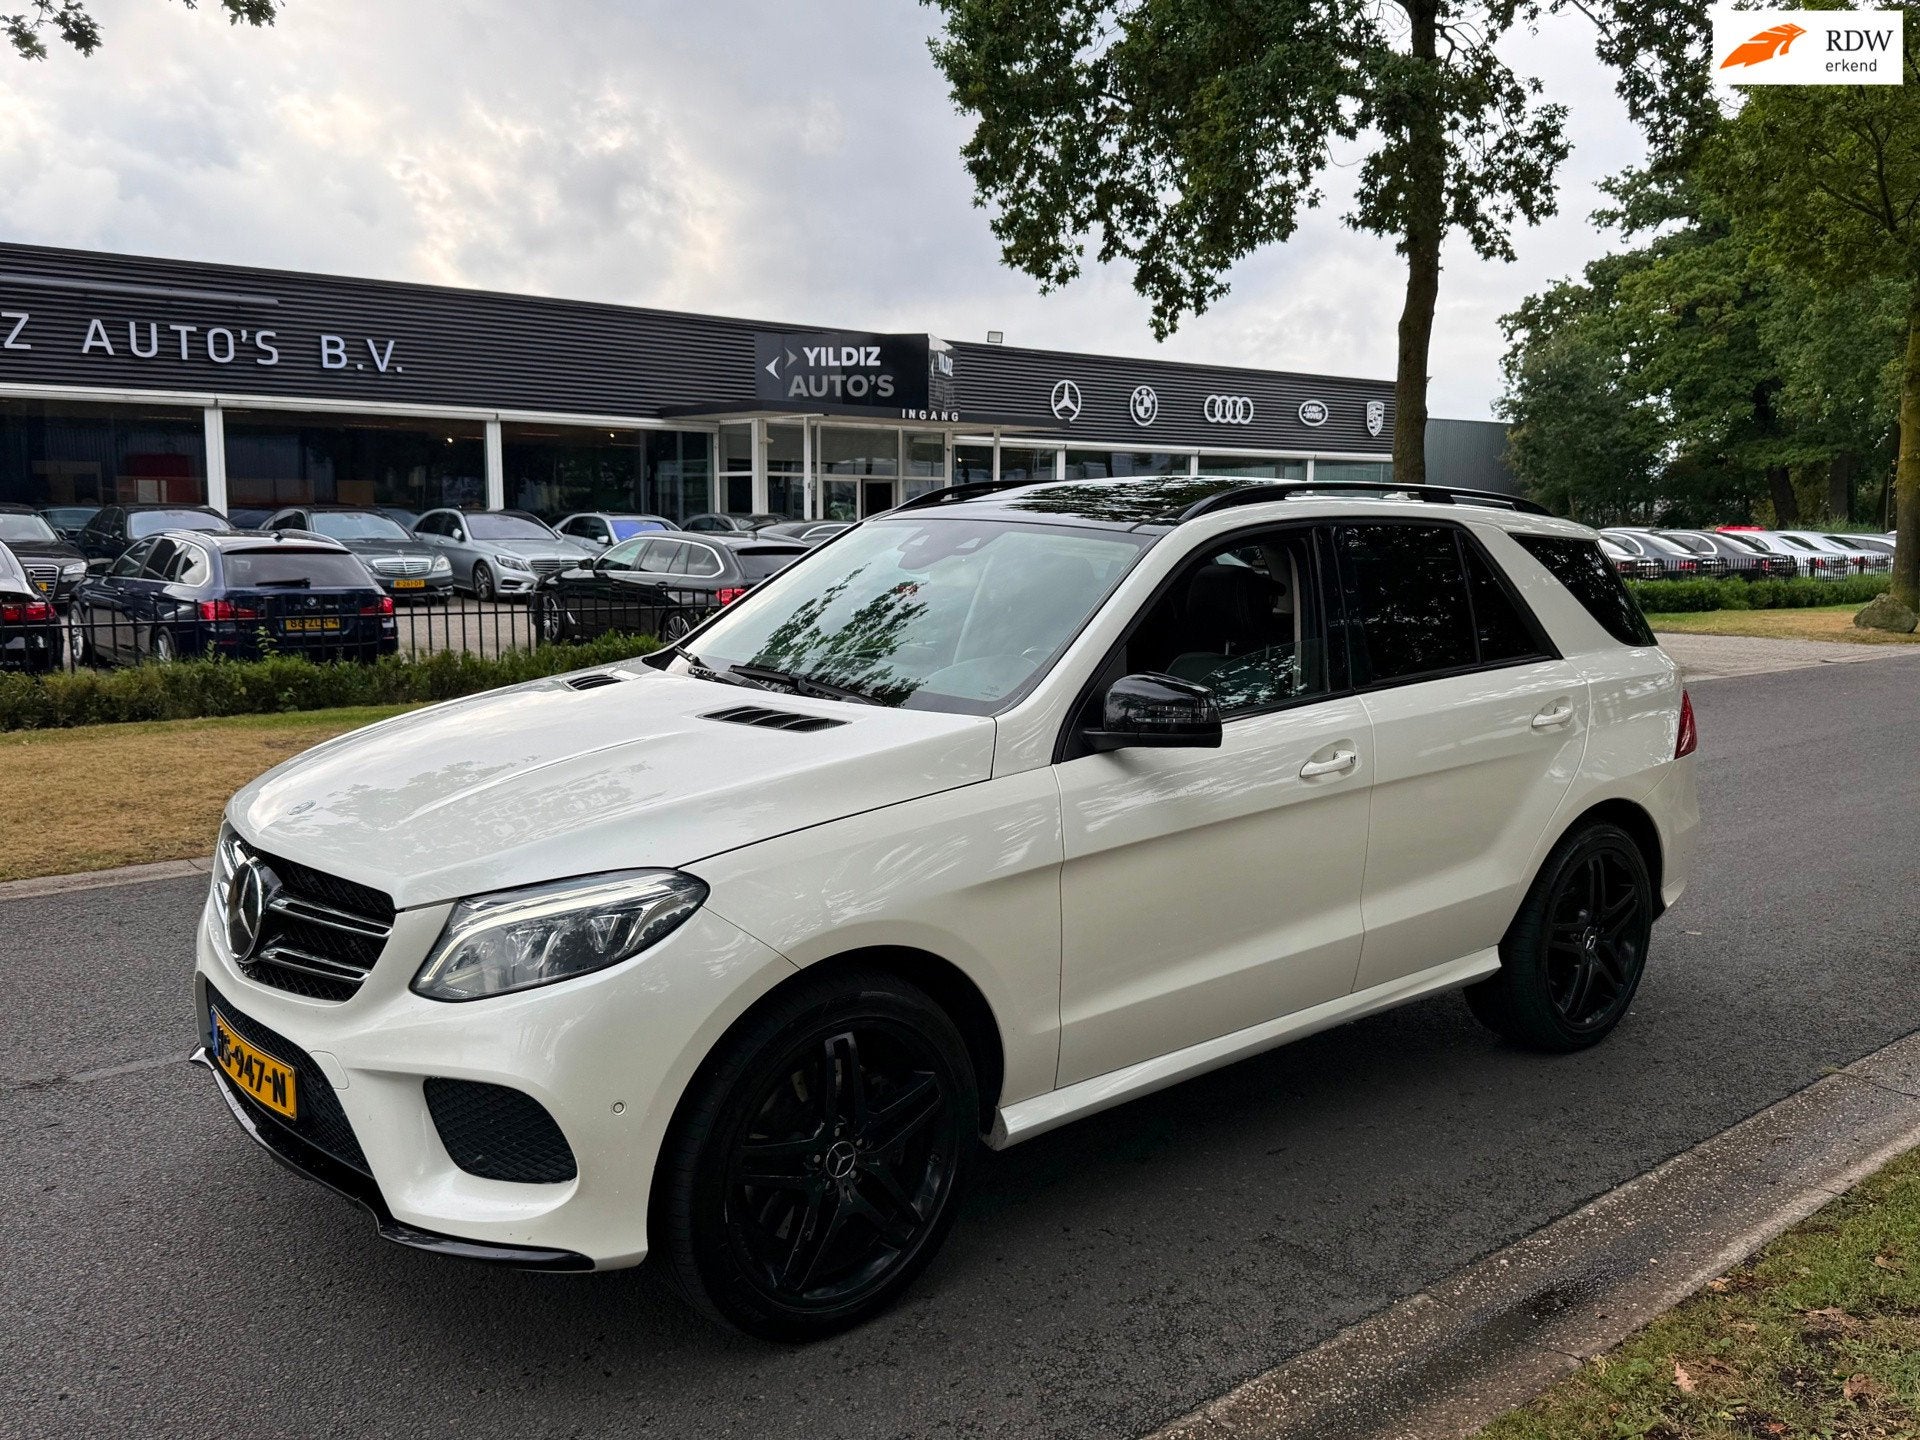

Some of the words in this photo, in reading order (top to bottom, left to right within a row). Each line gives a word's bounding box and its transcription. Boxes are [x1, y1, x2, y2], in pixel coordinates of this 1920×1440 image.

[1, 312, 32, 350] Z
[82, 318, 279, 366] AUTO'S
[320, 335, 403, 373] B.V.
[802, 346, 881, 367] YILDIZ
[788, 374, 895, 397] AUTO'S
[902, 408, 959, 421] INGANG
